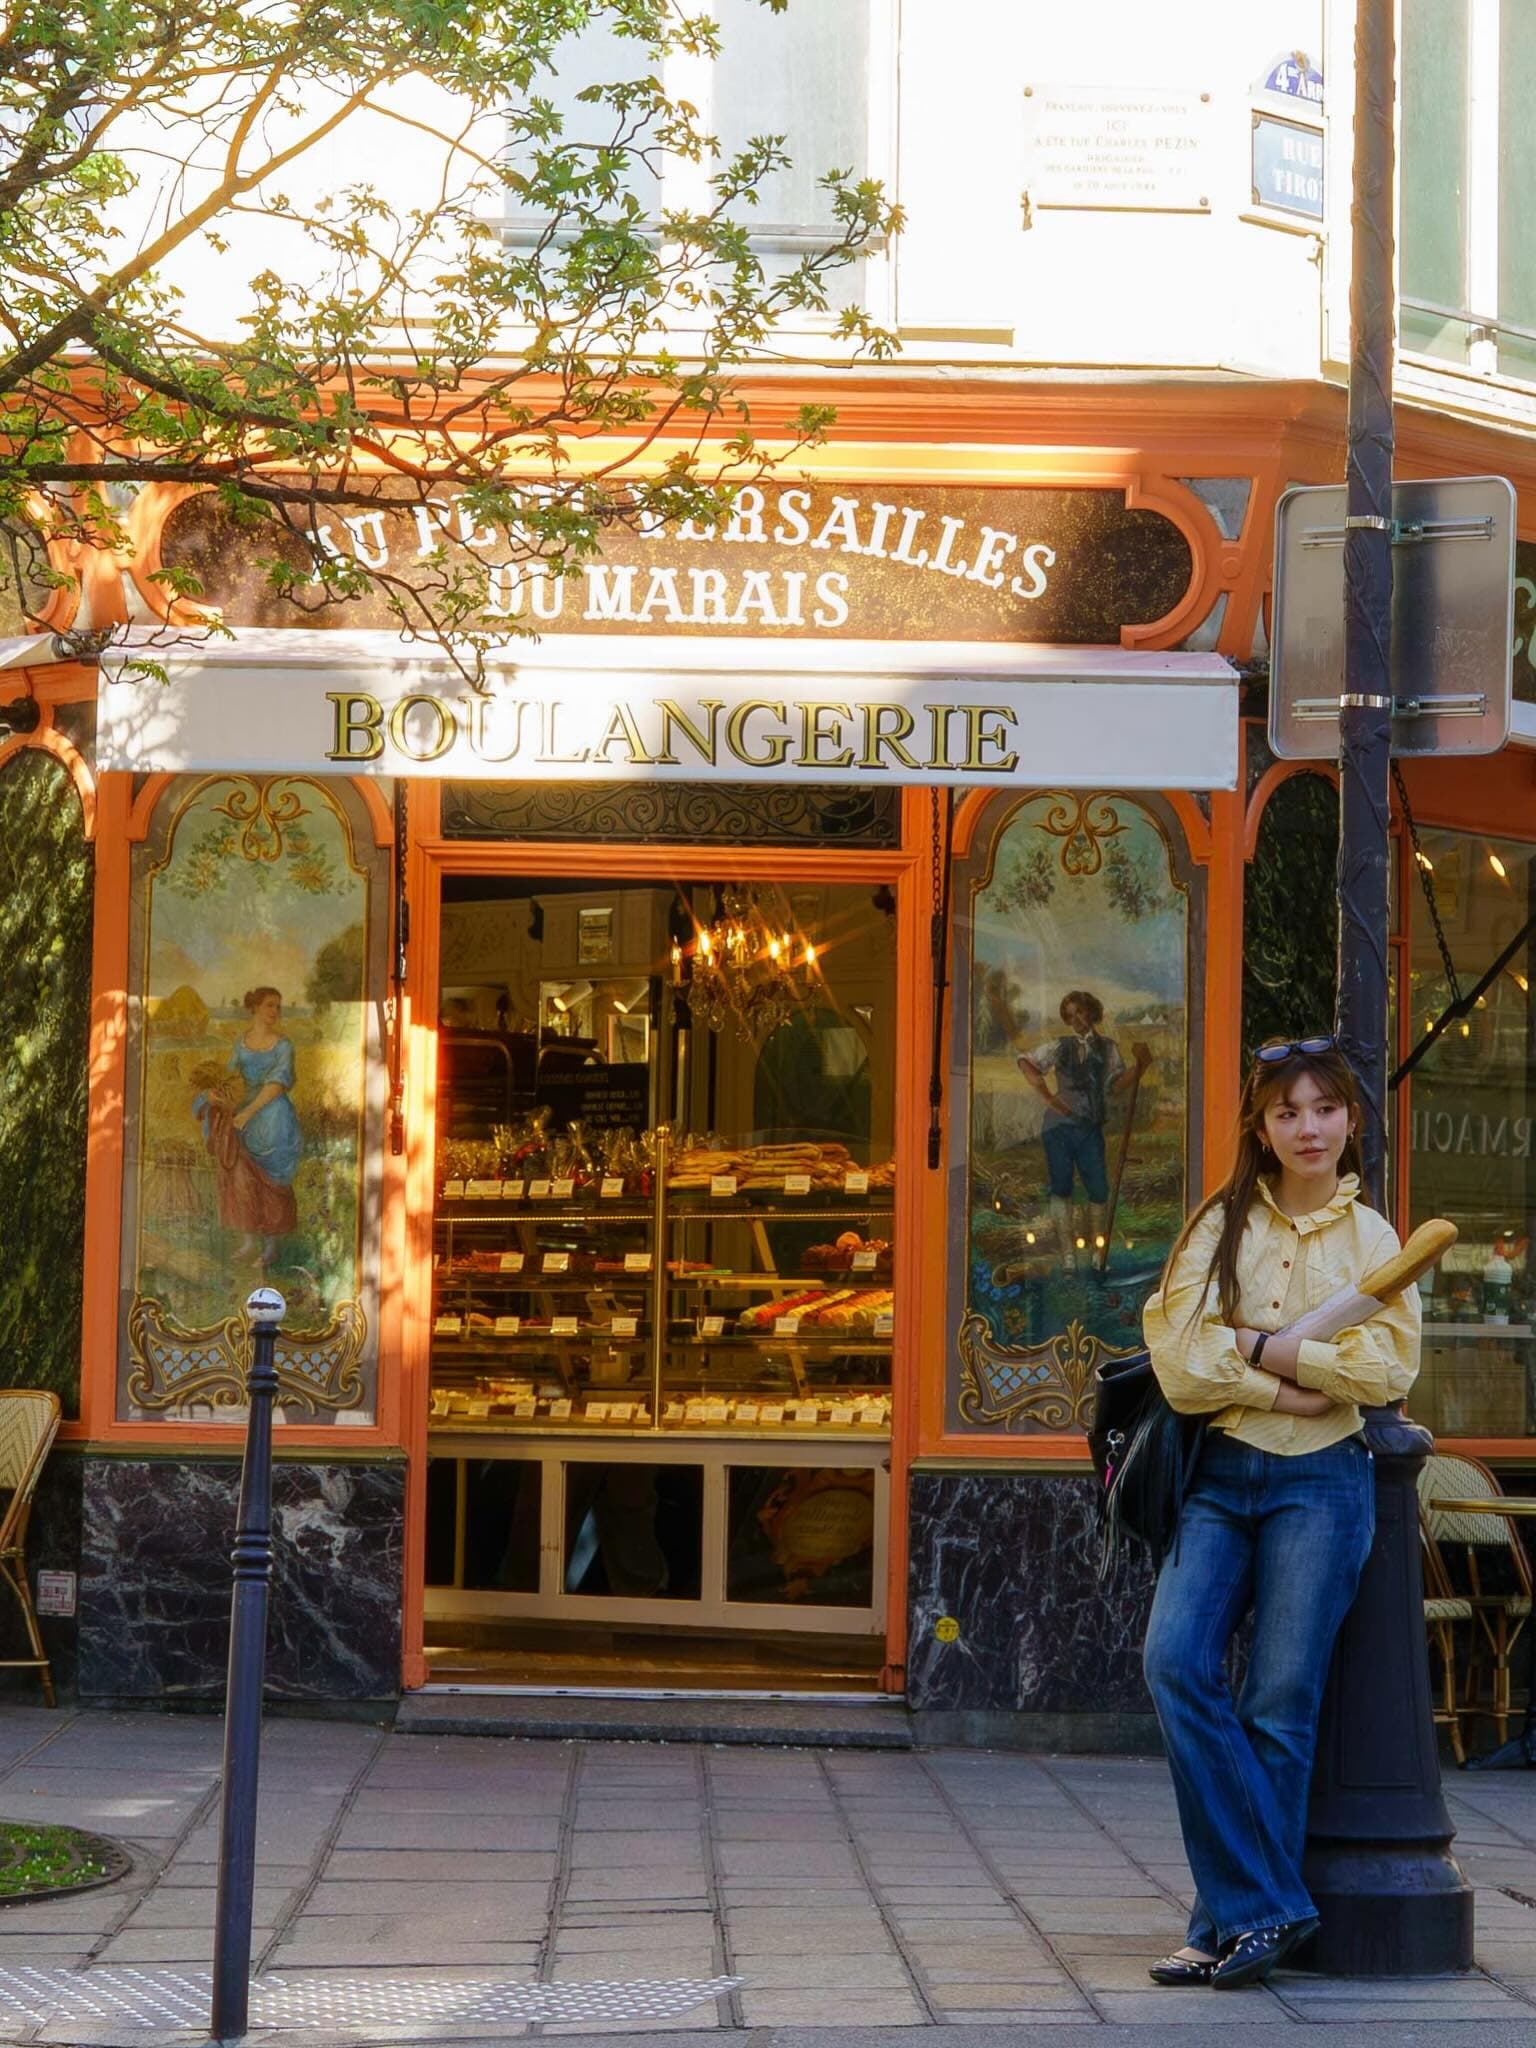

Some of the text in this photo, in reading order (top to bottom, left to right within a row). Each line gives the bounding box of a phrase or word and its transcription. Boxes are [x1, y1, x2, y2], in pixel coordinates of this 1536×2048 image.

[1272, 168, 1323, 200] TIRO
[483, 561, 849, 628] DU MARAIS
[325, 691, 1020, 773] BOULANGERIE
